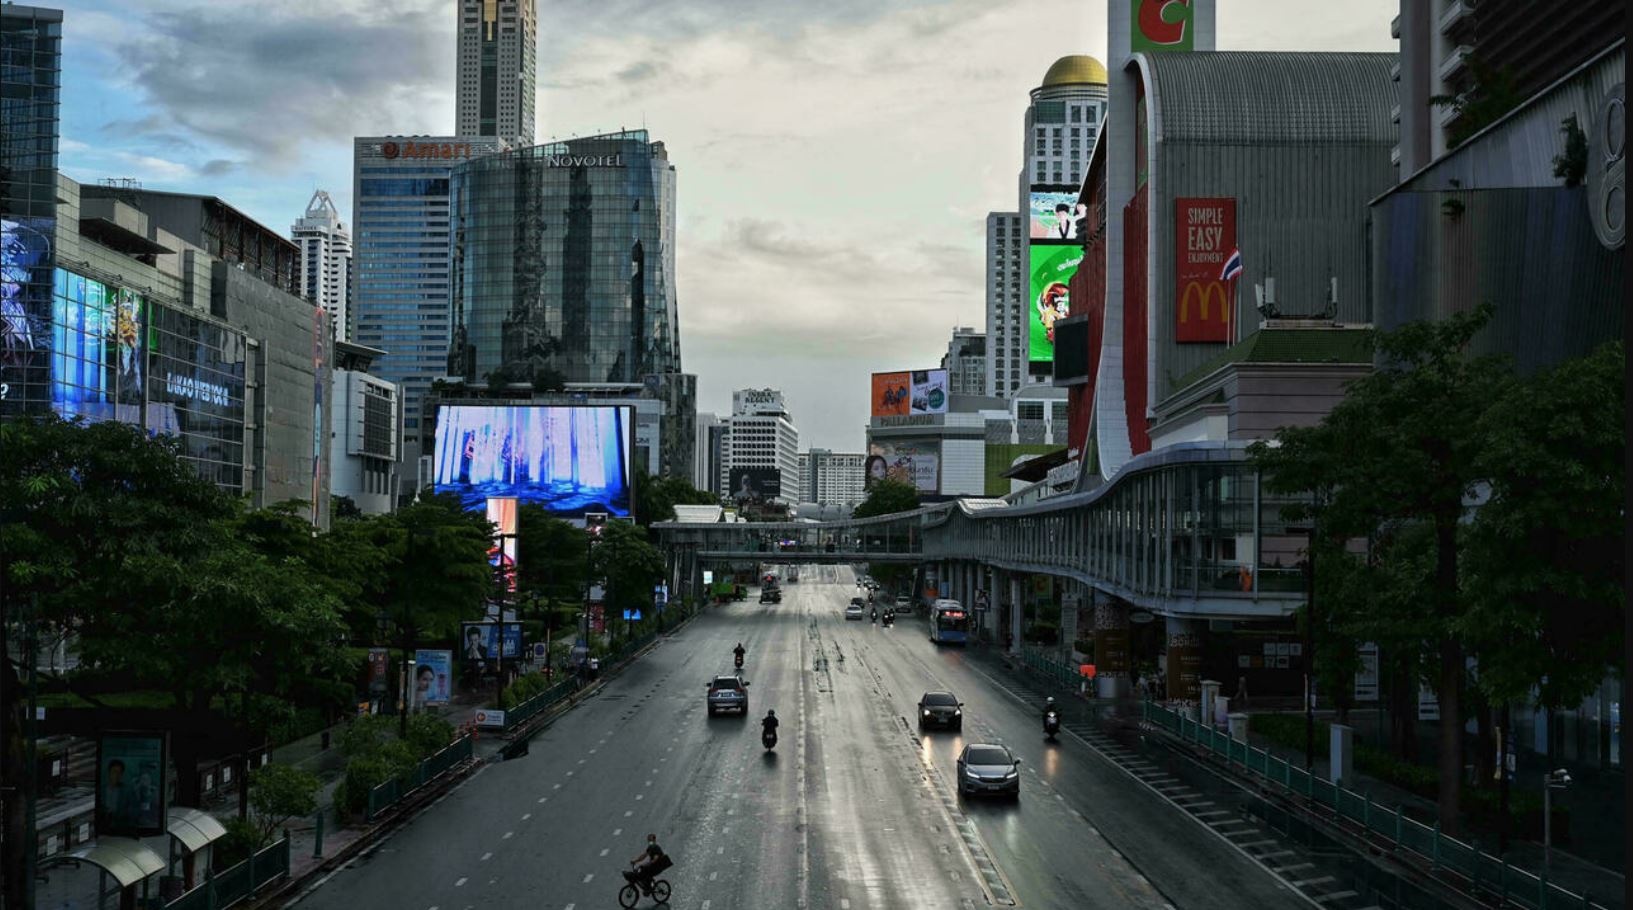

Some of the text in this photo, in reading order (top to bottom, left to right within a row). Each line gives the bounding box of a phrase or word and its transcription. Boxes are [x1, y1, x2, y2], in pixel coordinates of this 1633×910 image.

[402, 141, 472, 160] Amari
[546, 154, 623, 167] NOVOTEL
[1188, 207, 1224, 225] SIMPLE
[1188, 226, 1223, 251] EASY
[1188, 252, 1224, 264] ENJOYMENT
[880, 415, 935, 427] PALLADIUM
